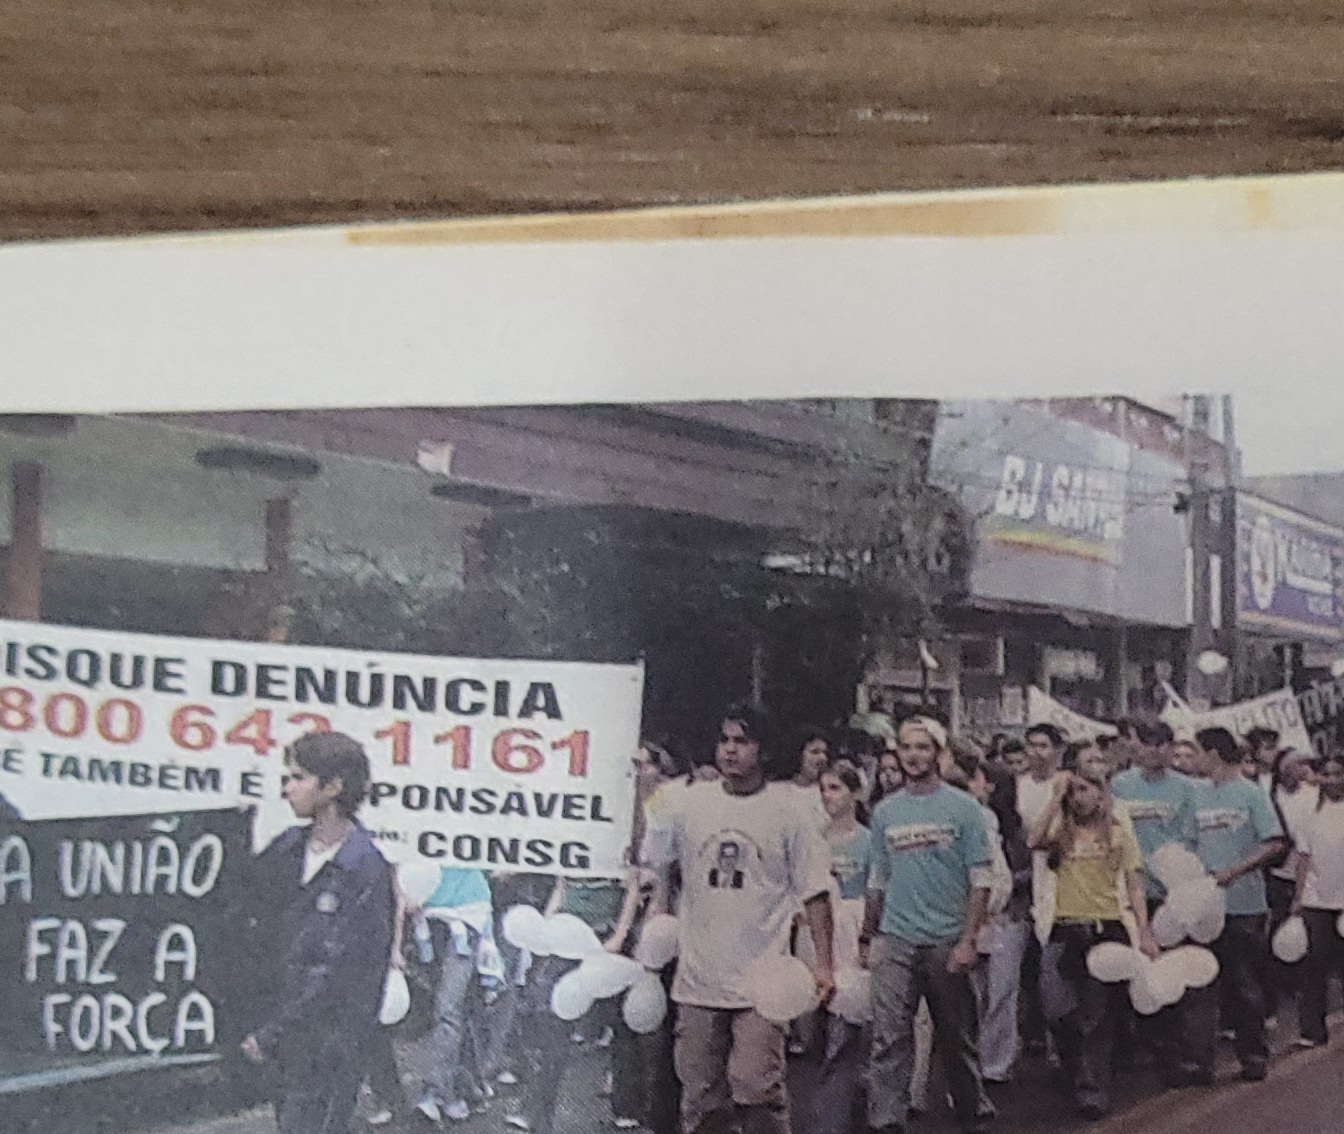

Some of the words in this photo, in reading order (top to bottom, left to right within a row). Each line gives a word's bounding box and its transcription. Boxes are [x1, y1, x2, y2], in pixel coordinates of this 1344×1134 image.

[210, 658, 564, 722] DENÚNCIA
[374, 720, 591, 778] 1161
[39, 751, 222, 793] TAMBÉM
[362, 781, 614, 823] PONSÁVEL
[59, 816, 225, 898] UNIÃO
[417, 830, 591, 870] CONSG
[25, 917, 128, 984] FAZ
[155, 923, 197, 982] A
[42, 989, 216, 1056] FORÇA
